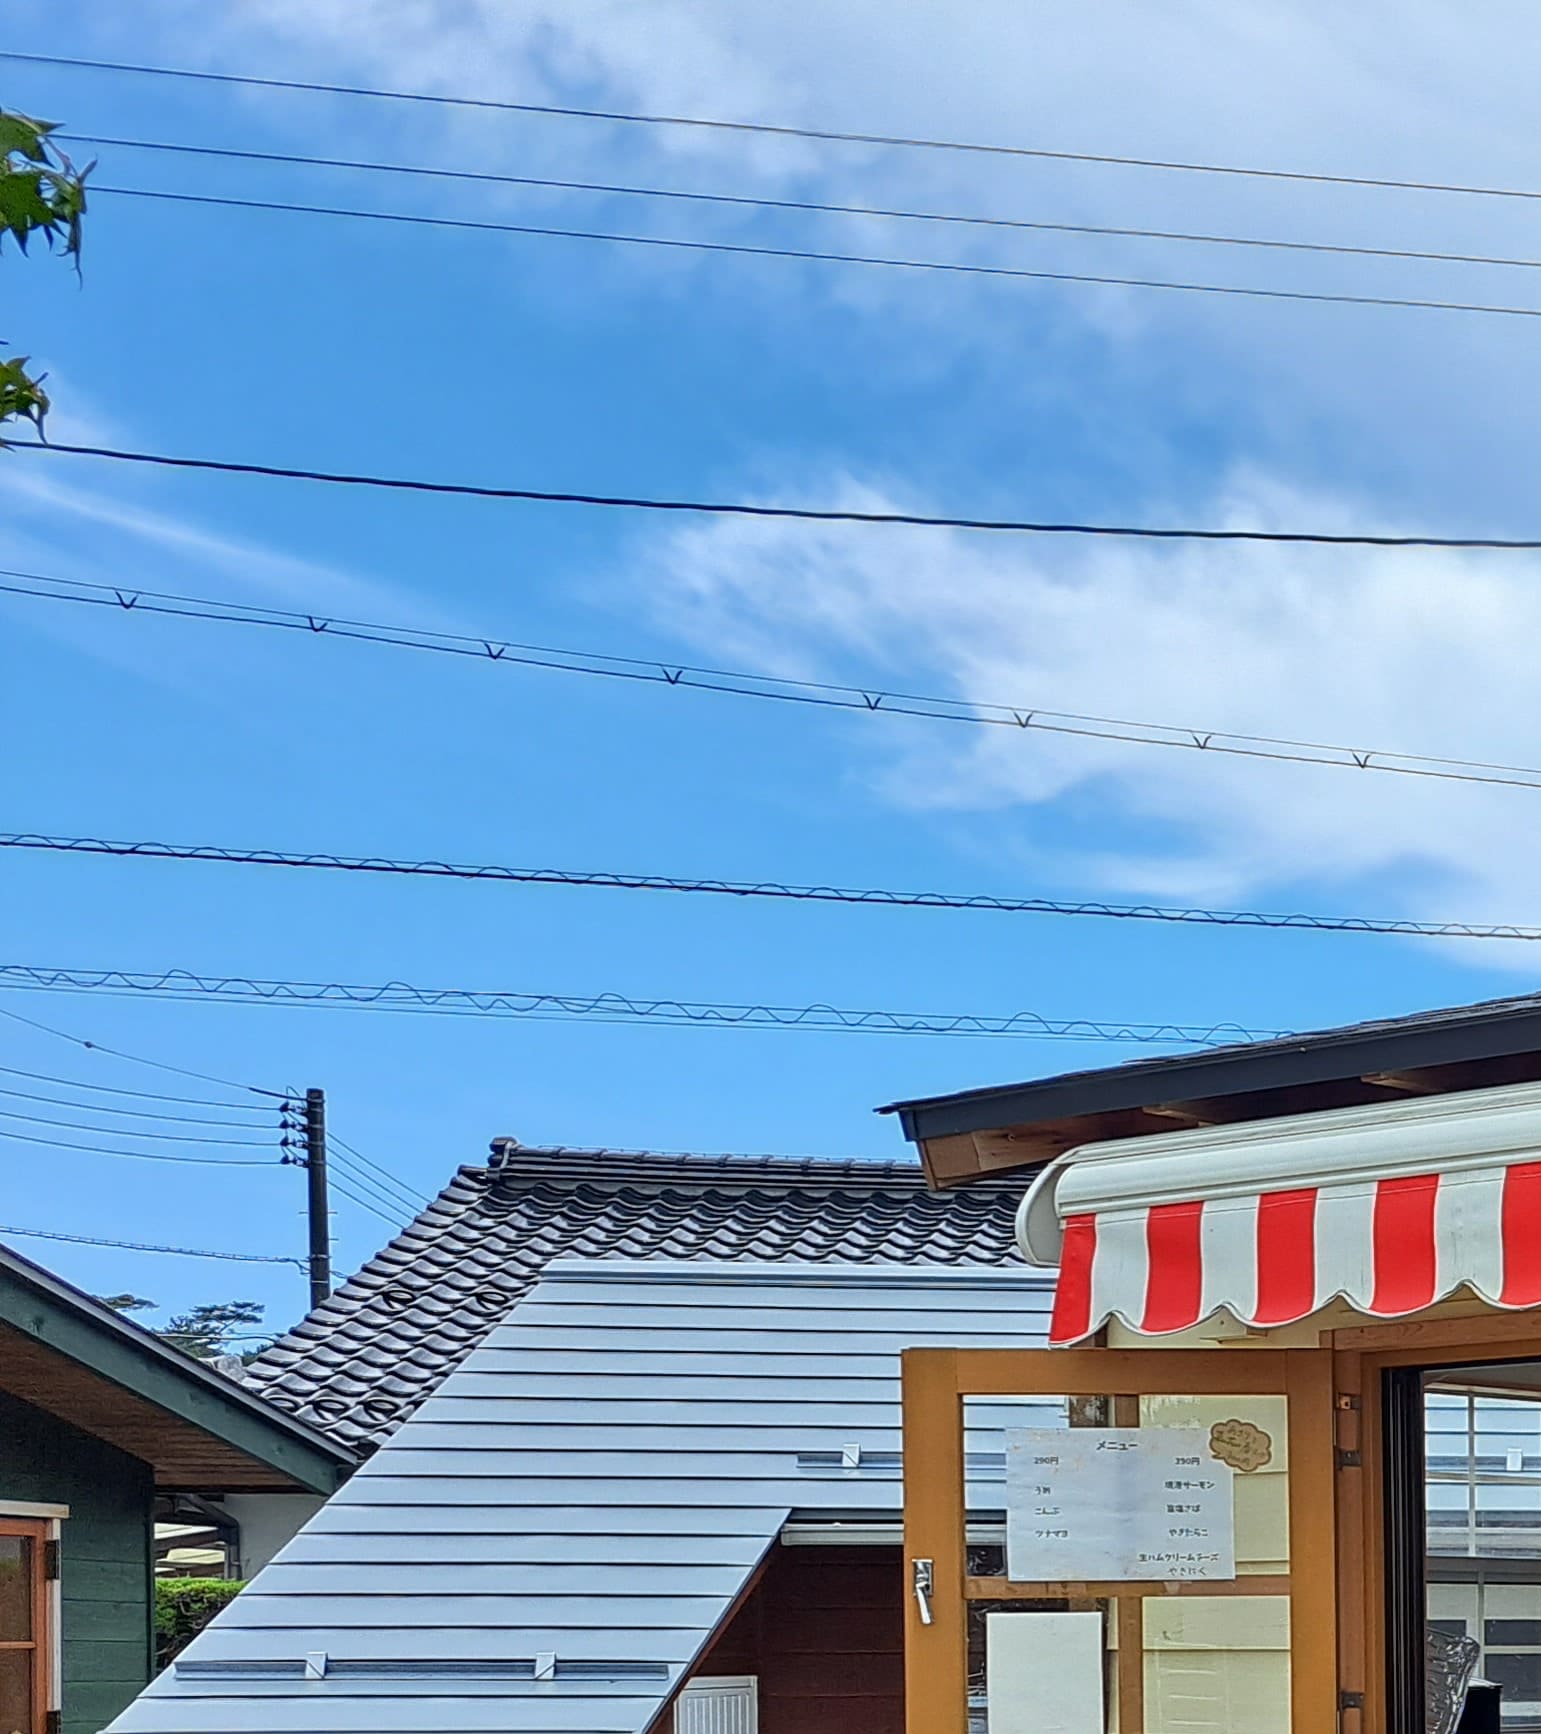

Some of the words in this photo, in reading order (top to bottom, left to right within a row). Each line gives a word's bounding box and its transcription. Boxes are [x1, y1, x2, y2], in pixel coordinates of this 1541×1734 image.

[1096, 1440, 1138, 1451] メニュー
[1035, 1456, 1060, 1466] 290円
[1035, 1506, 1061, 1515] こんぶ
[1035, 1528, 1069, 1539] ツナマヨ
